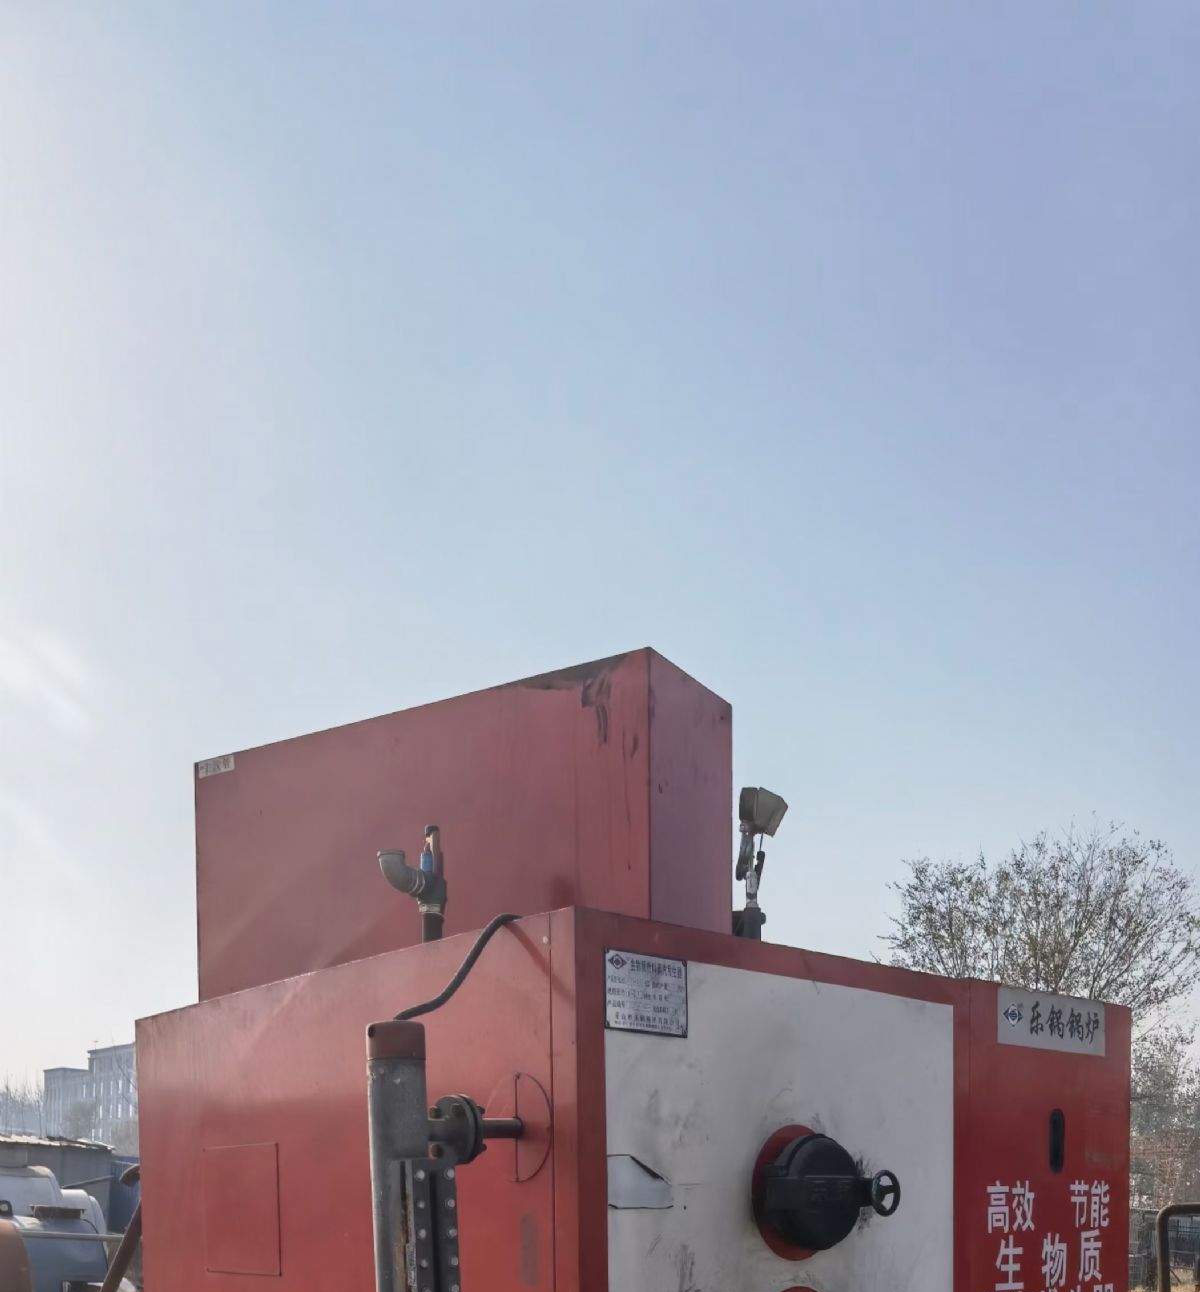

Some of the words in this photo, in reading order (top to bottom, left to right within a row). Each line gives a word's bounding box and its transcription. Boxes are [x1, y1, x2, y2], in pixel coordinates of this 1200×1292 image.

[986, 1180, 1036, 1234] 高效
[1070, 1179, 1110, 1228] 节能
[995, 1229, 1103, 1291] 生物质
